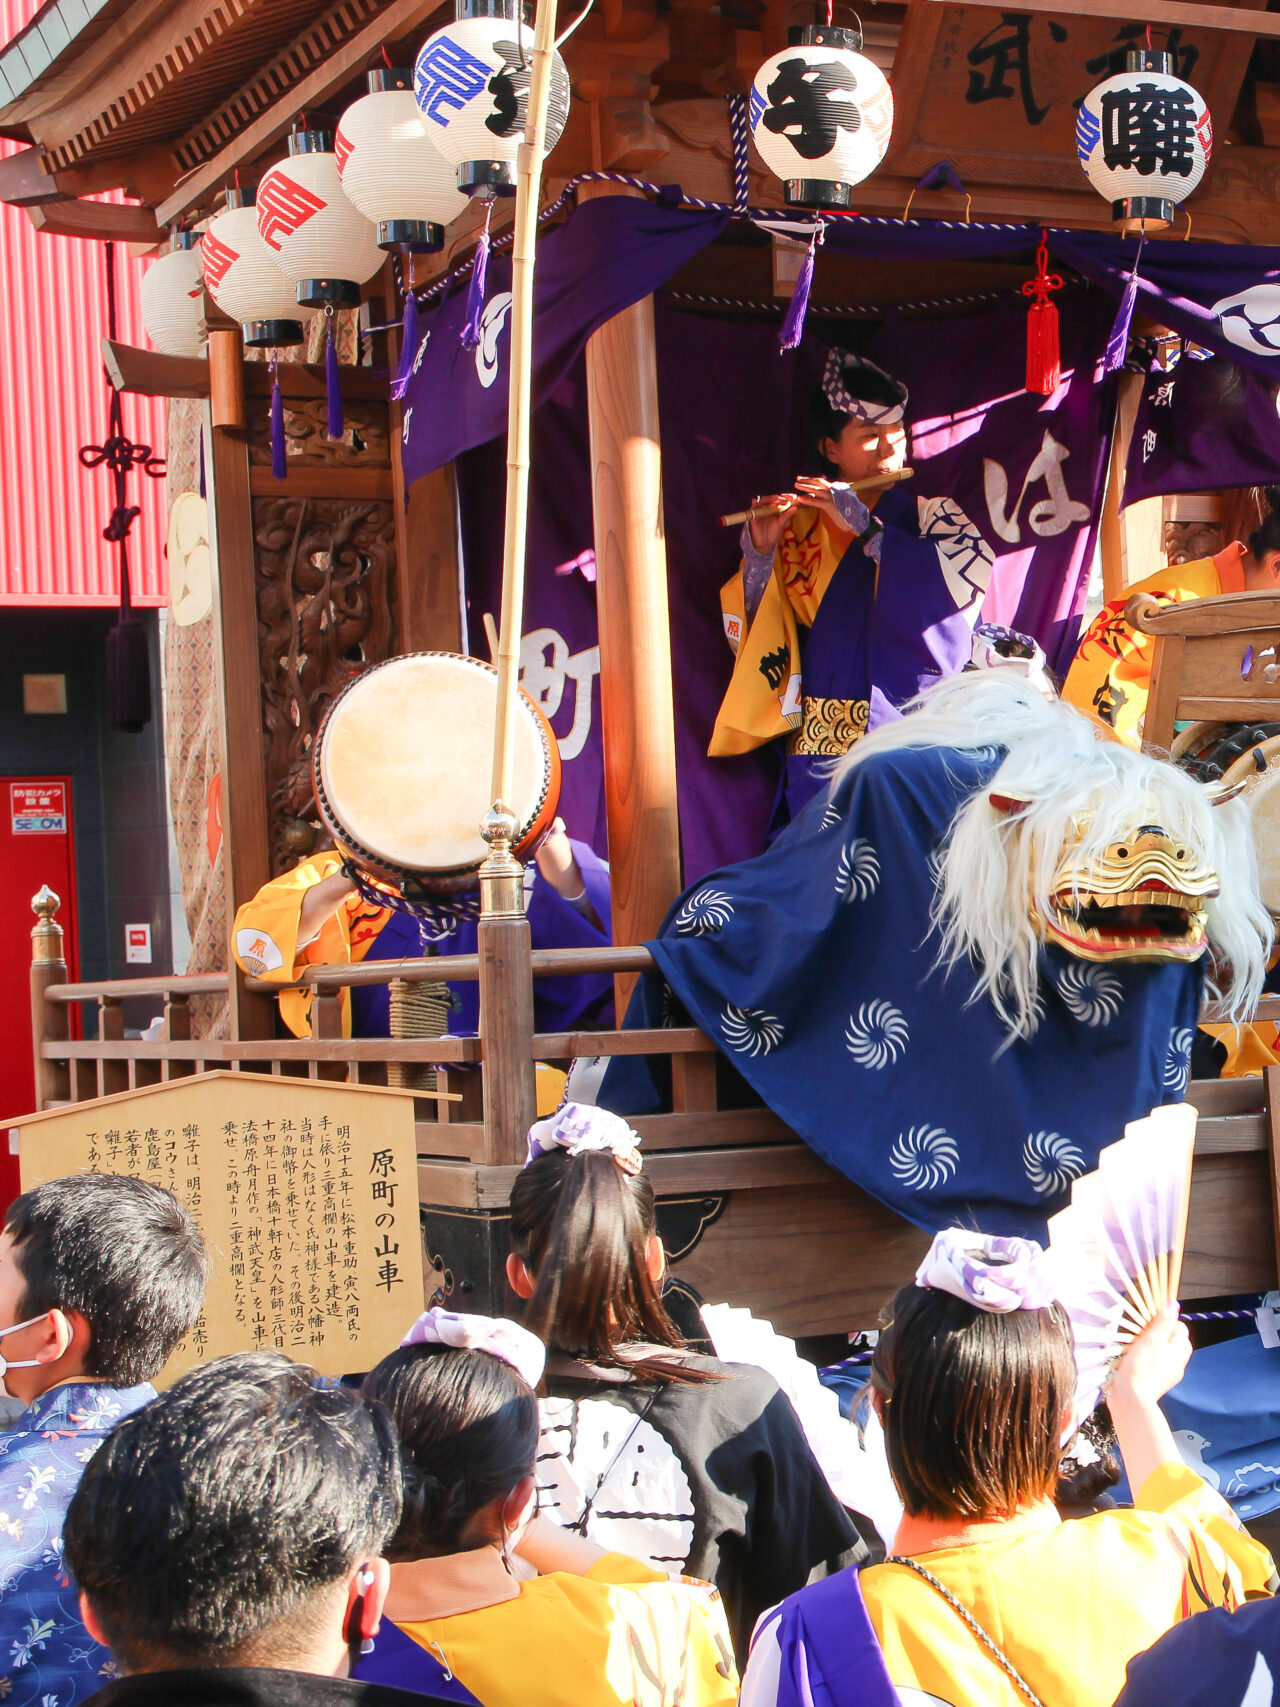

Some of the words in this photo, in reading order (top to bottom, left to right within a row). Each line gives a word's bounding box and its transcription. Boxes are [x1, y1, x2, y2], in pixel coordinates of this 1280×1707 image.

[763, 58, 861, 159] 子
[1100, 82, 1197, 177] 囃
[15, 817, 63, 830] SECOM
[369, 1149, 404, 1293] 原町の山車
